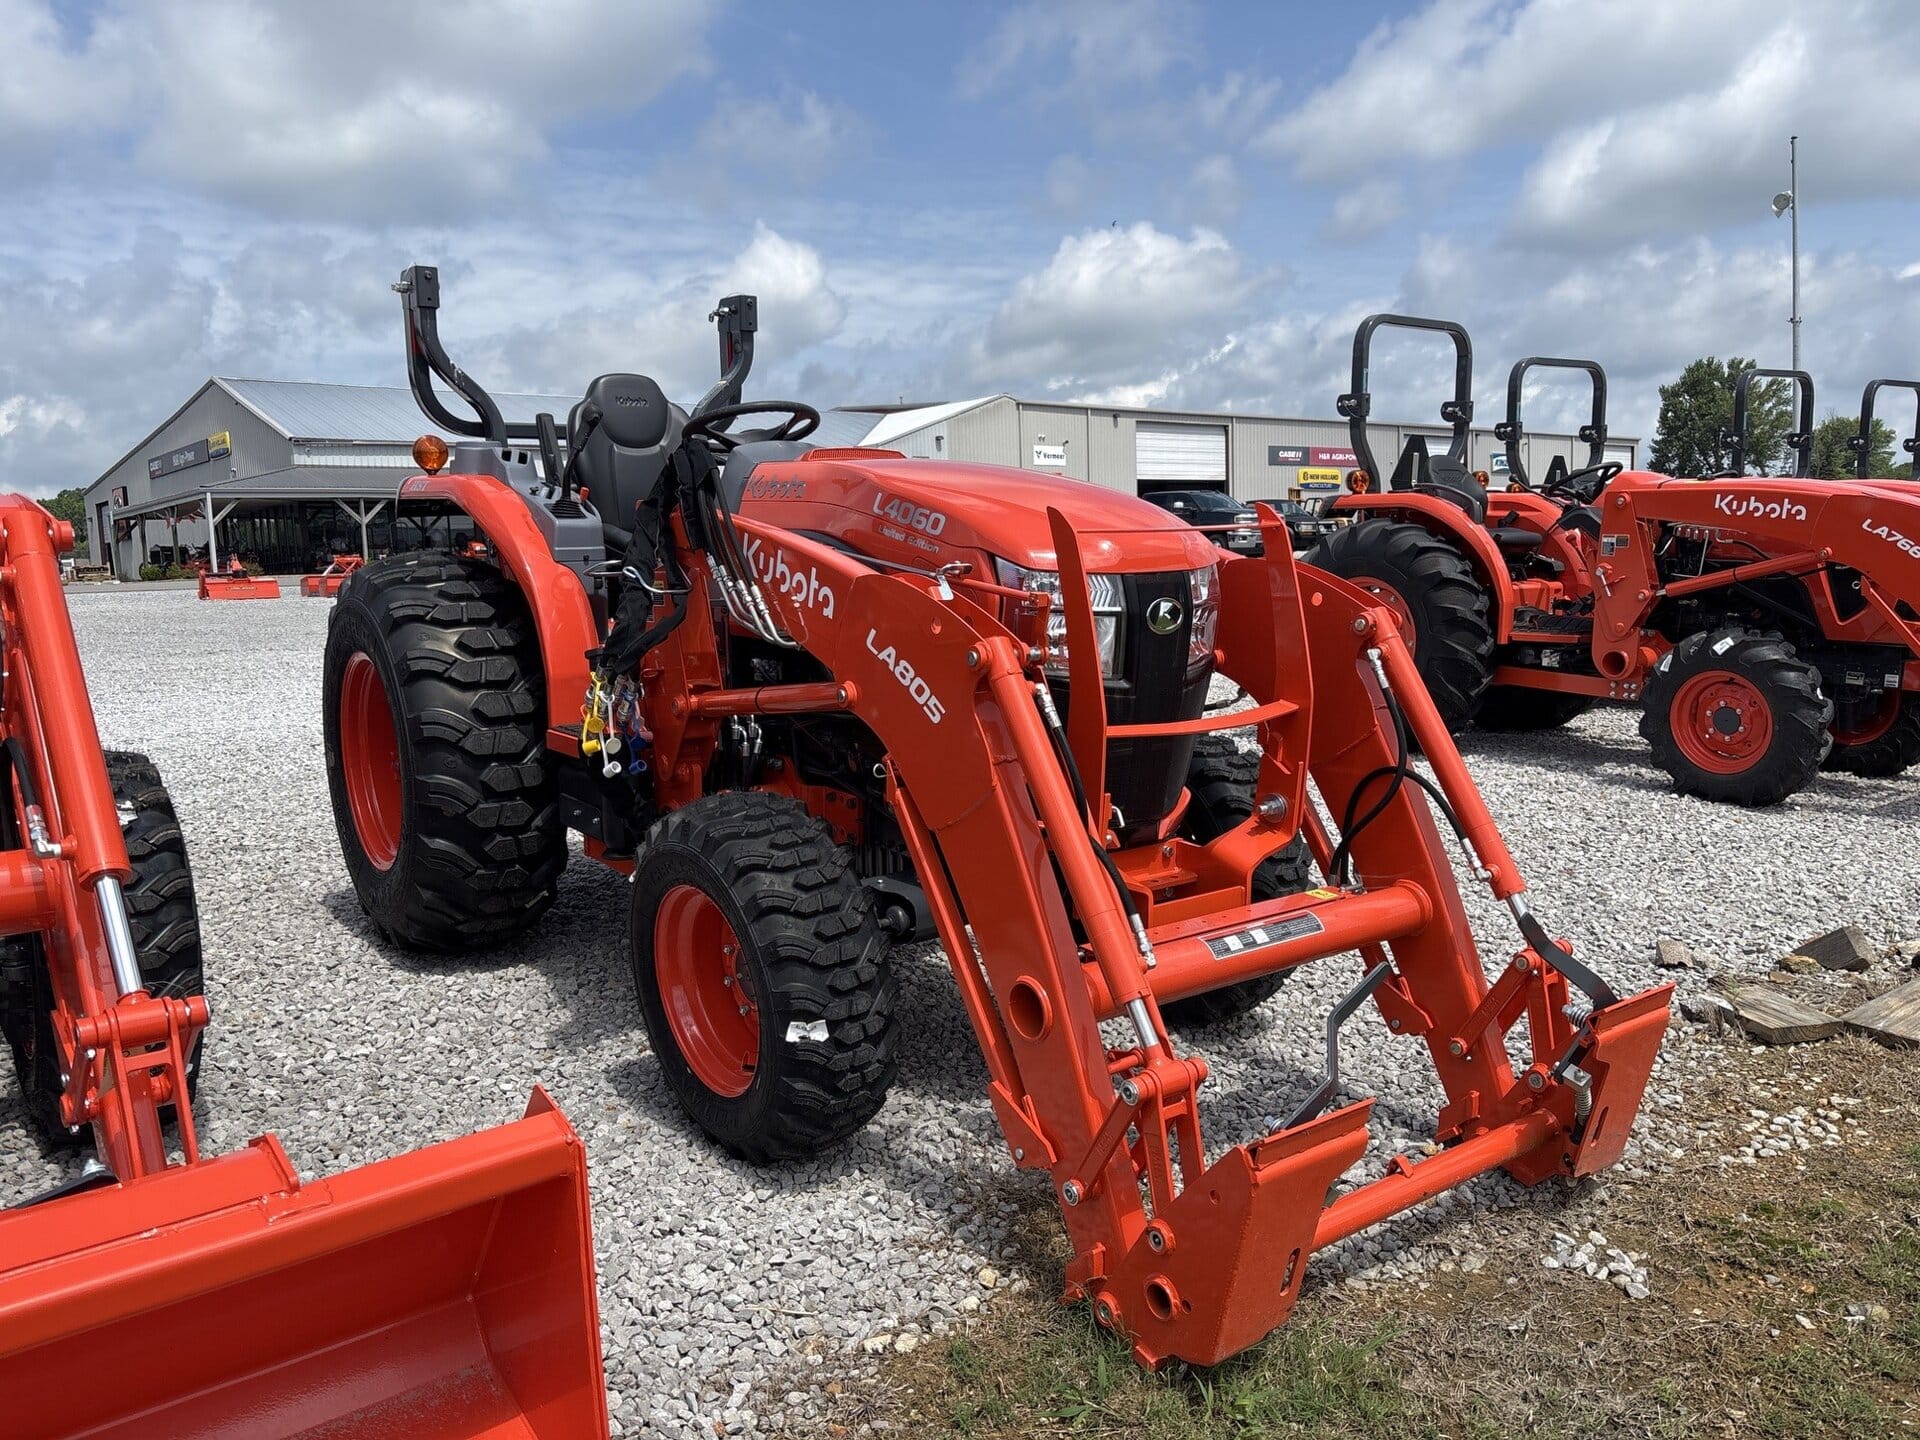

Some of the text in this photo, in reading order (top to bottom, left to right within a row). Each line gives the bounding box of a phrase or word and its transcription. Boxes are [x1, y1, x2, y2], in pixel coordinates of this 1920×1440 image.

[1331, 453, 1357, 461] AGRI-POW
[749, 474, 807, 499] Kubota
[872, 492, 946, 536] L4060
[1714, 493, 1808, 521] Kubota
[878, 524, 940, 554] Limited Edition
[742, 532, 834, 620] Kubota
[866, 628, 946, 724] LA805
